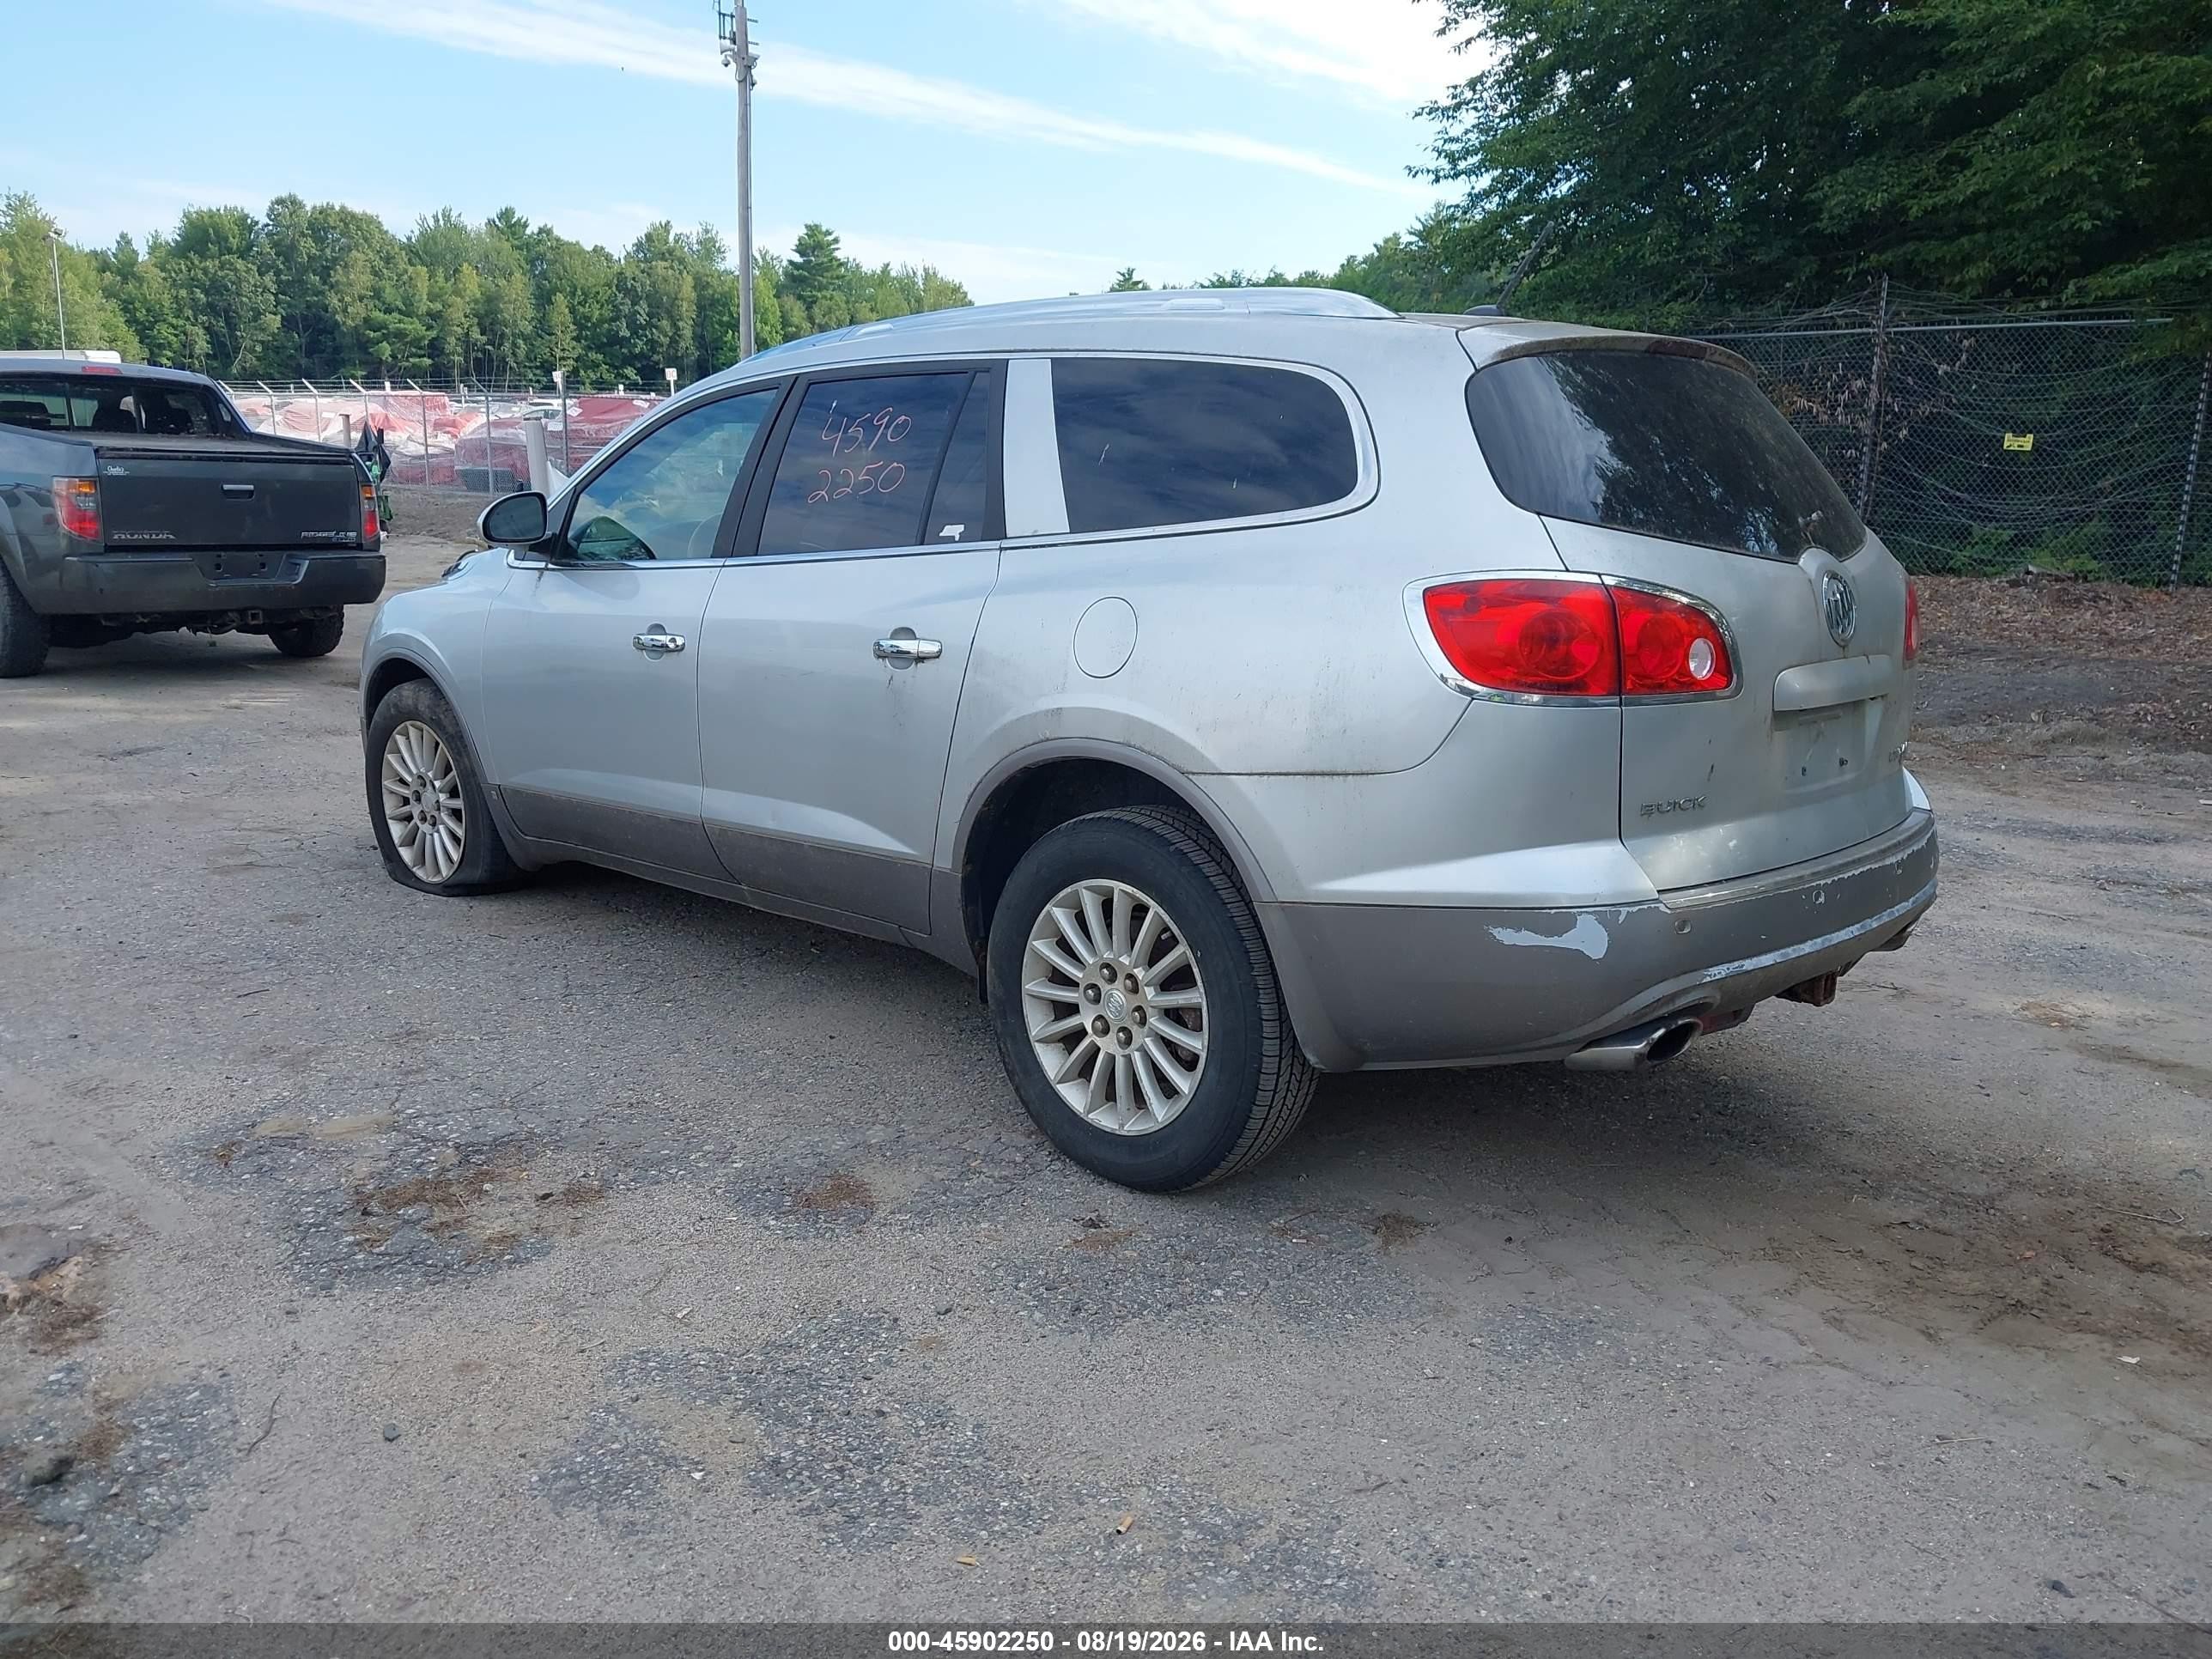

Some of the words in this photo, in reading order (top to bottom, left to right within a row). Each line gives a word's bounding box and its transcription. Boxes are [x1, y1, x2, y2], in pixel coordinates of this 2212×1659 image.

[821, 406, 913, 458] 4590
[807, 461, 906, 504] 2250
[112, 530, 177, 539] HONDA
[1640, 796, 1706, 817] BUICK
